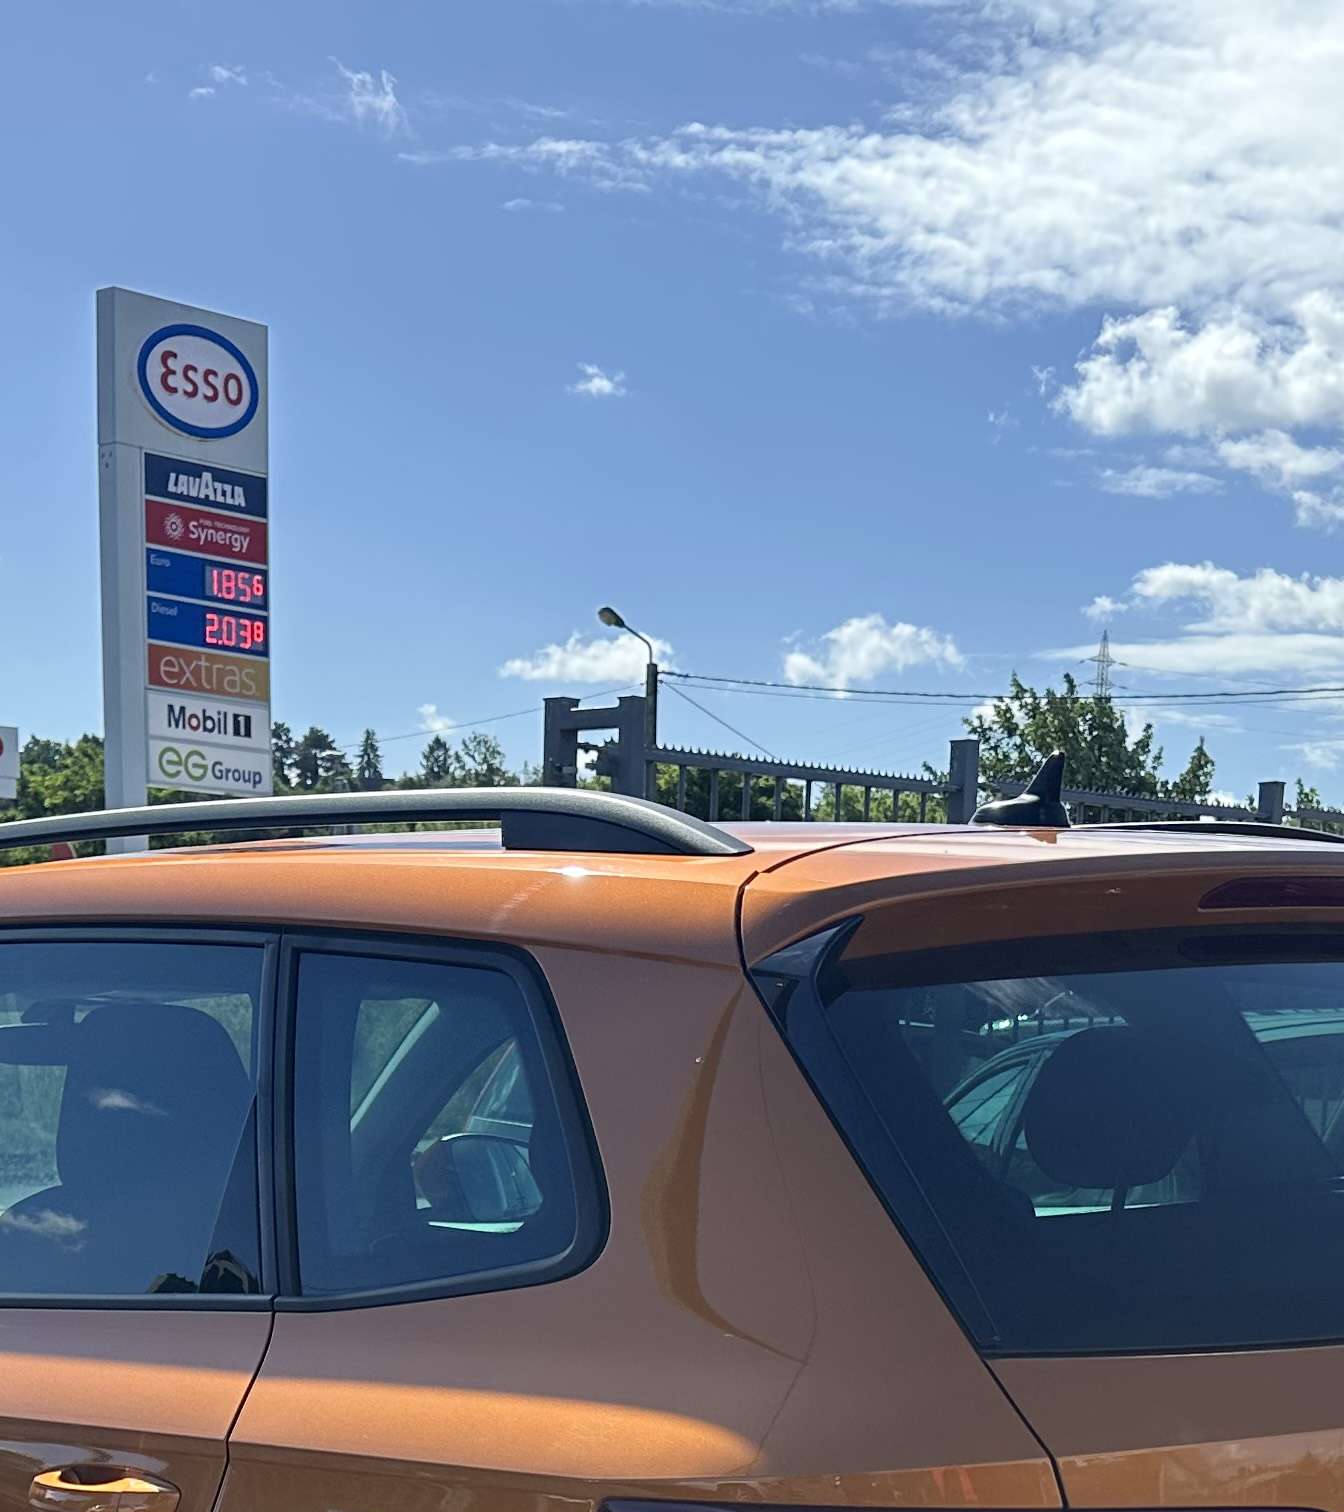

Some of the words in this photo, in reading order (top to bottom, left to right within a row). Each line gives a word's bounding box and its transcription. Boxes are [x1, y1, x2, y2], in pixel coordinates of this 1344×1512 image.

[167, 472, 247, 507] LAVAZZA
[188, 521, 251, 553] Synergy
[159, 655, 257, 695] extras
[167, 704, 228, 736] Mobil
[211, 761, 263, 786] Group
